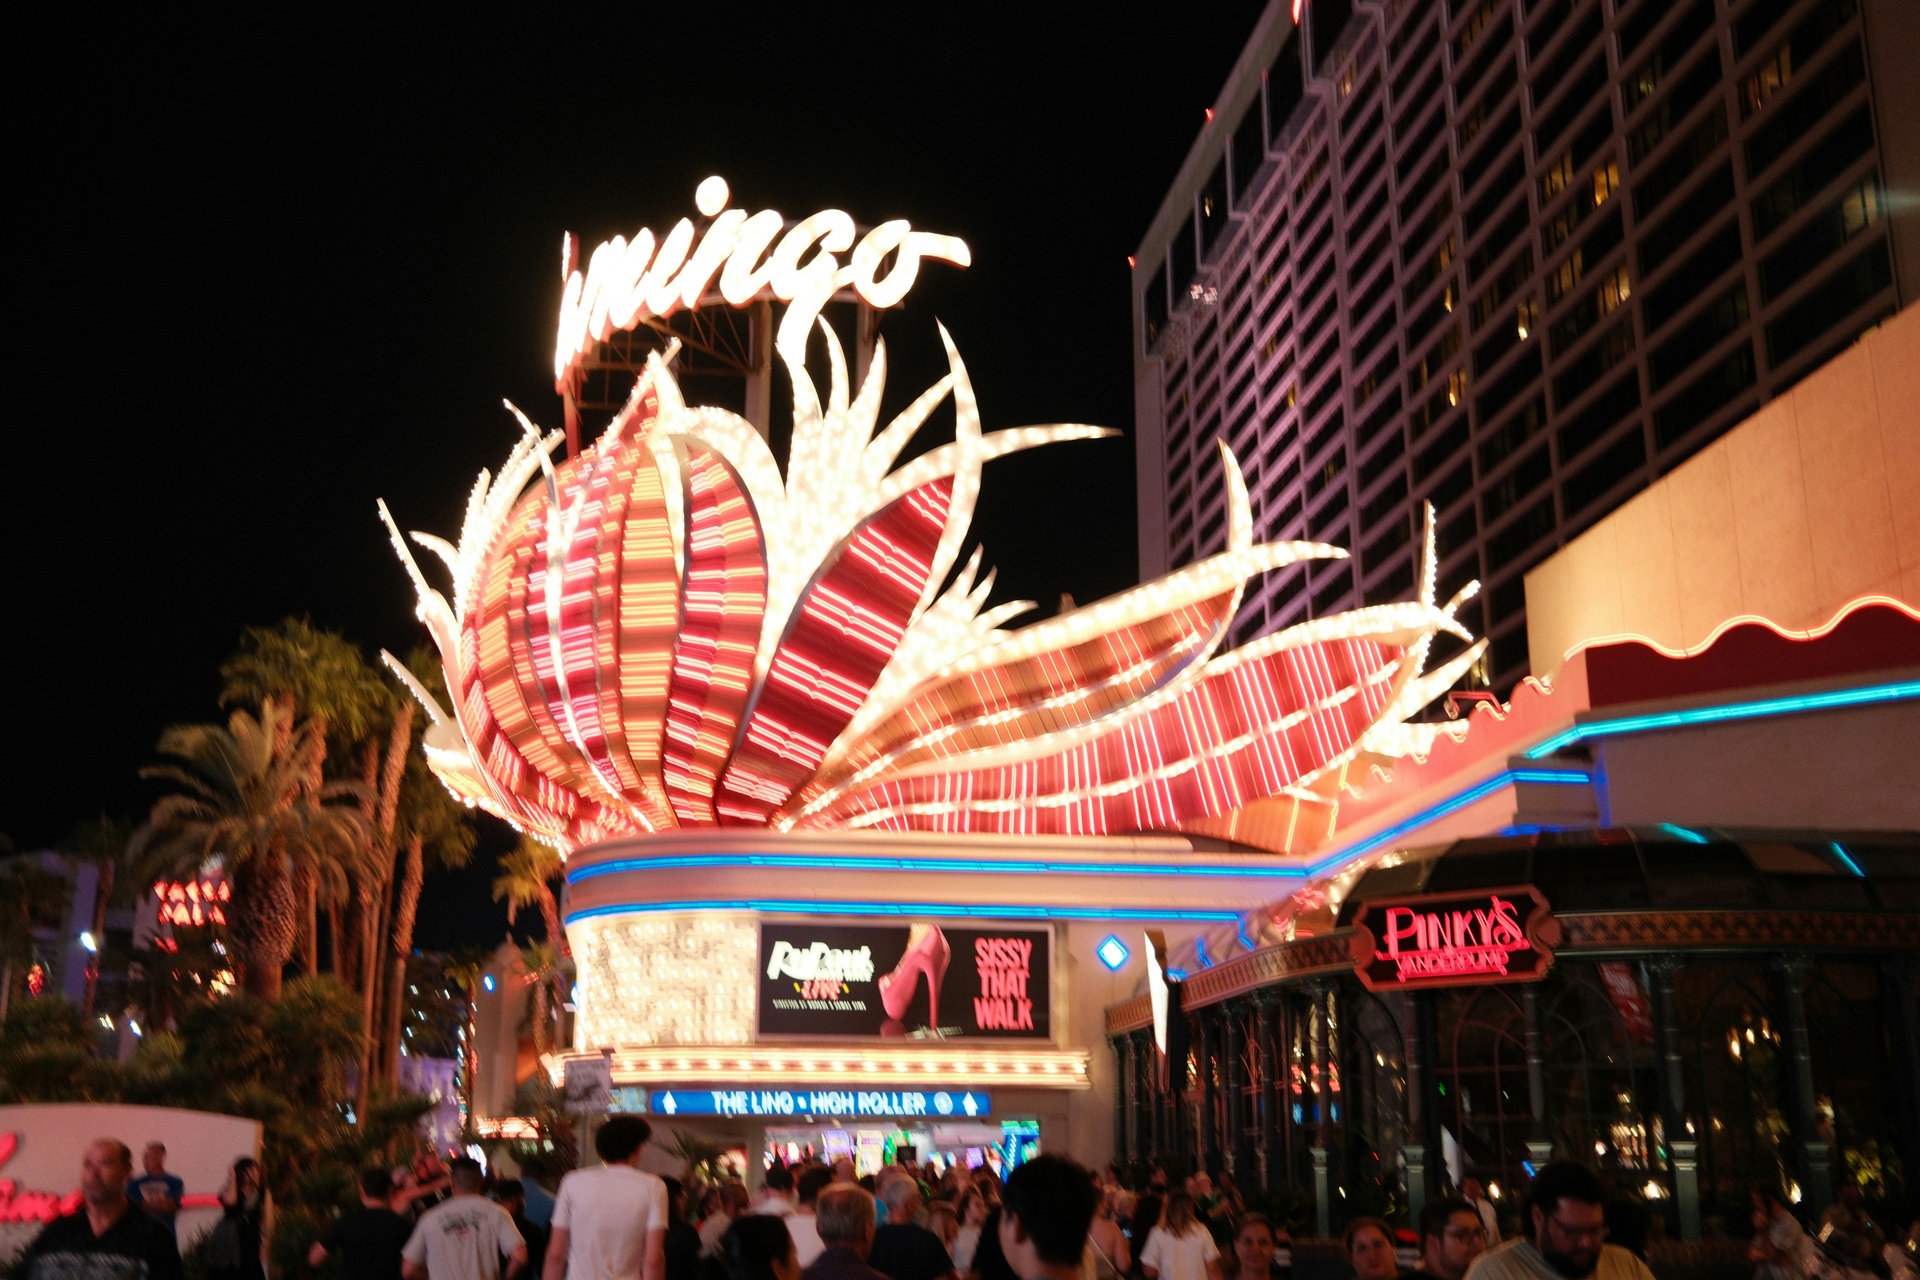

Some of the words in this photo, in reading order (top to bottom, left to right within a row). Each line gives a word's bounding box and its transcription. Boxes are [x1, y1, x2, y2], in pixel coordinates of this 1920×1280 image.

[975, 937, 1032, 970] SISSY
[1400, 948, 1509, 975] VANDERPUMP
[977, 966, 1030, 999] THAT
[973, 997, 1034, 1030] WALK
[711, 1091, 748, 1114] THE
[810, 1091, 854, 1114] HIGH
[858, 1091, 926, 1115] ROLLER
